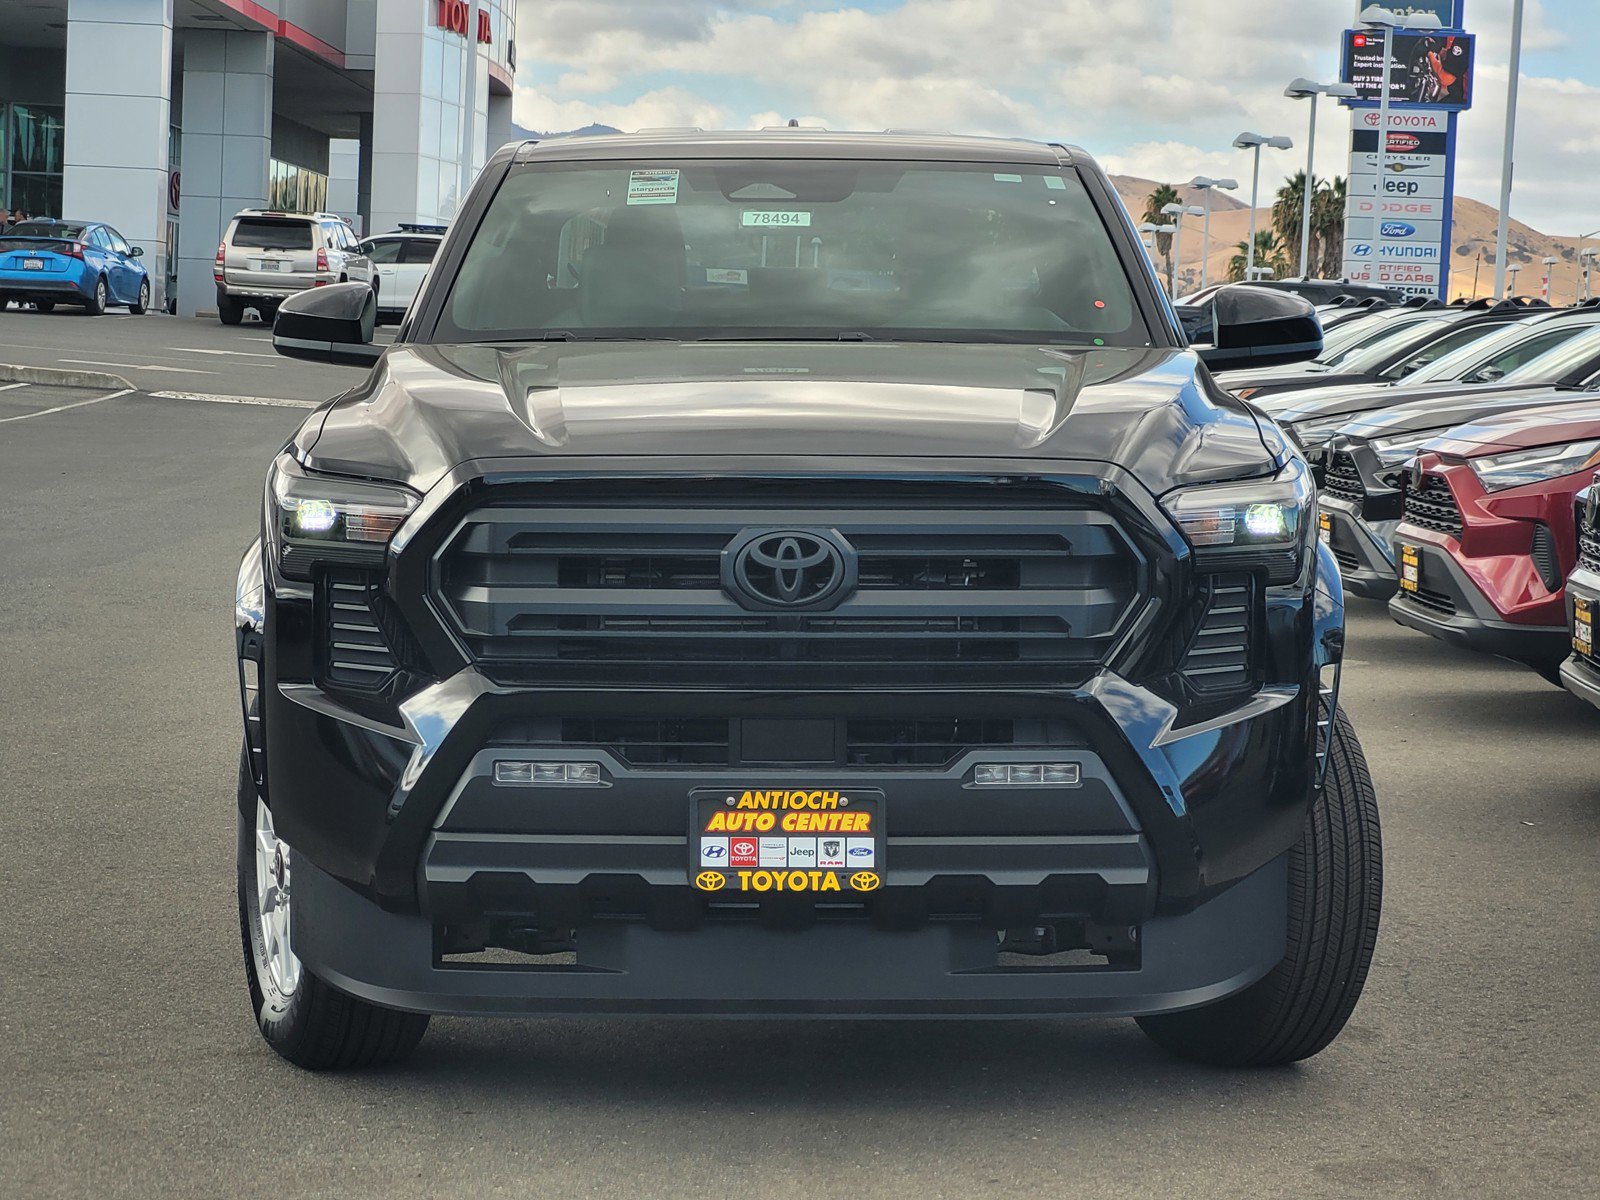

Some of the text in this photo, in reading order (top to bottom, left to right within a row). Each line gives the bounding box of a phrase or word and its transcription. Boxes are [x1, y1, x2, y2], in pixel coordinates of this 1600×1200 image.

[437, 0, 492, 44] TOYTA
[1387, 115, 1437, 127] TOYOTA
[752, 213, 800, 224] 78494
[1382, 224, 1407, 235] Ford
[1379, 246, 1437, 258] HYUNDAI
[1364, 264, 1422, 272] CRTIFIED
[1351, 272, 1434, 283] USD CARS
[736, 791, 839, 810] ANTIOCH
[705, 812, 871, 832] AUTO CENTER
[790, 847, 815, 857] Jeep
[852, 848, 869, 856] Ford
[738, 872, 841, 891] TOYOTA
